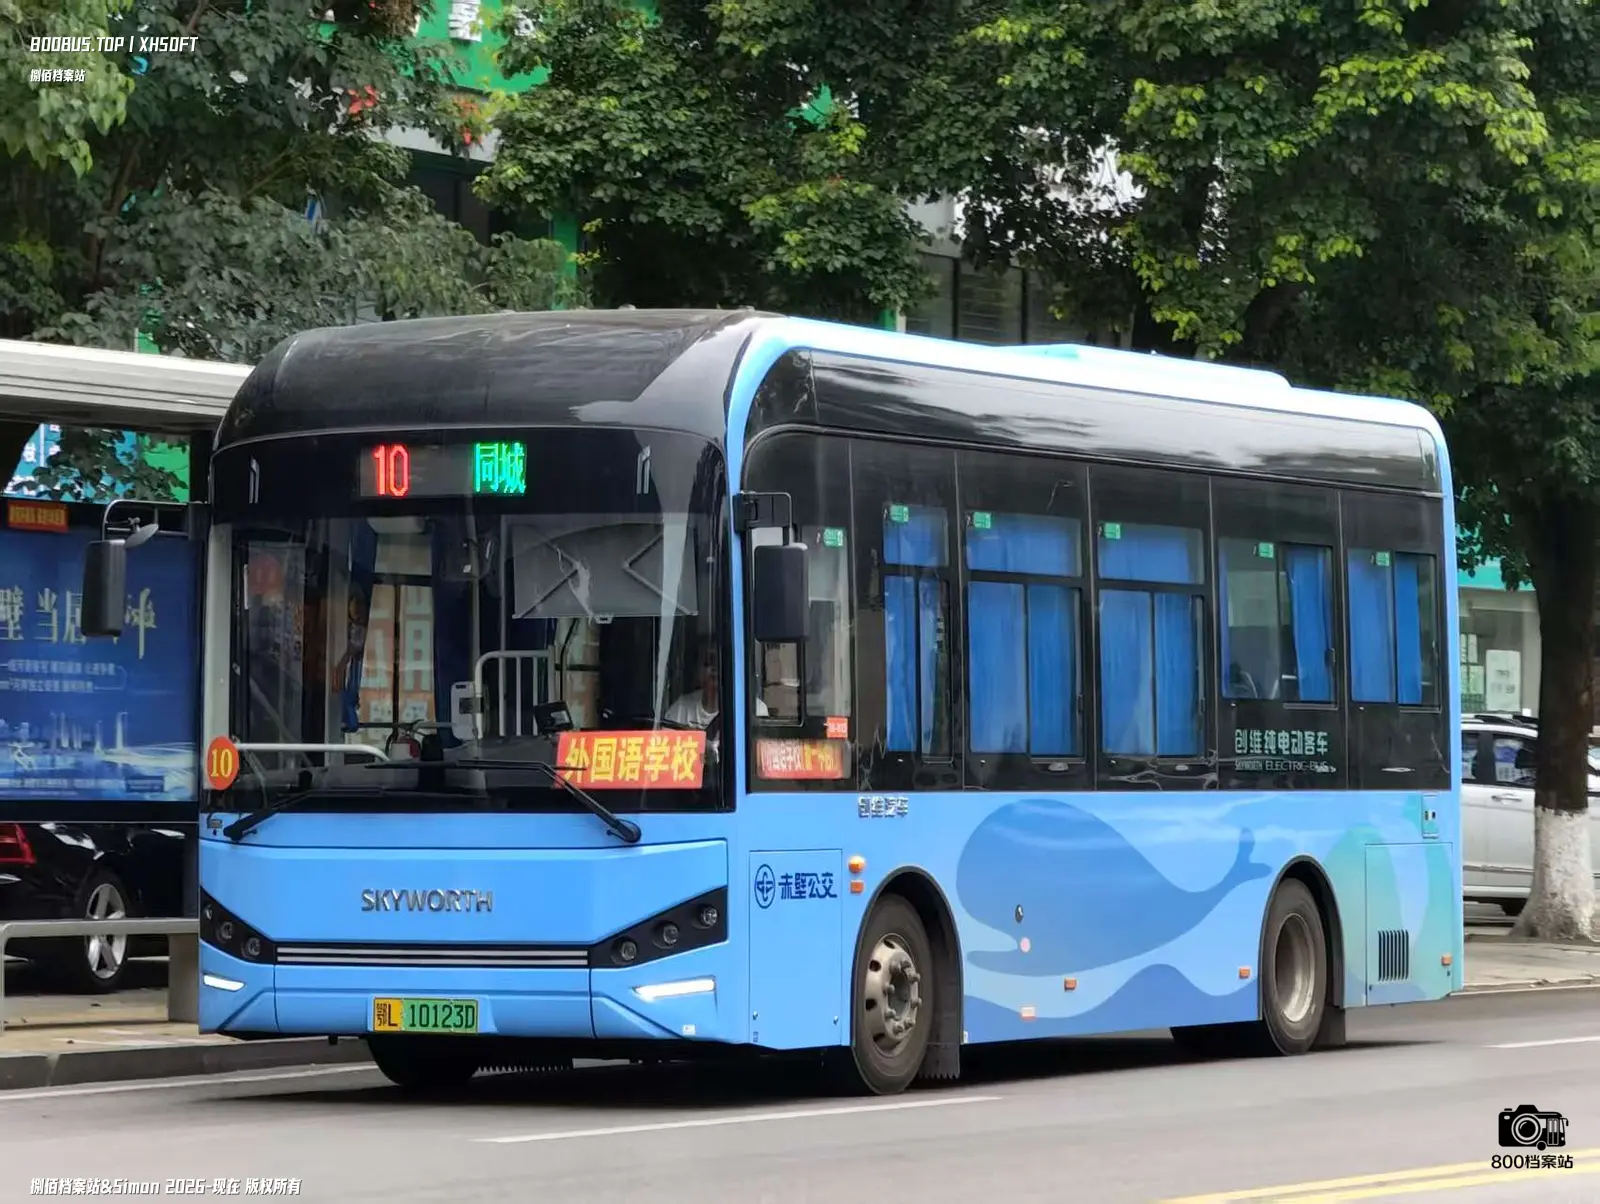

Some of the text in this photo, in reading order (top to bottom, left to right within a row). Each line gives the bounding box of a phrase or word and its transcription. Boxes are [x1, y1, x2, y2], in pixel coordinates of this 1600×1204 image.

[373, 444, 410, 497] 10
[474, 442, 527, 494] 同城
[1234, 729, 1329, 755] 创维纯电动客车
[211, 748, 233, 777] 10
[564, 736, 700, 783] 外国语学校
[778, 872, 838, 900] 赤壁公交
[361, 889, 493, 913] SKYWORTH
[409, 1004, 475, 1028] 10123D
